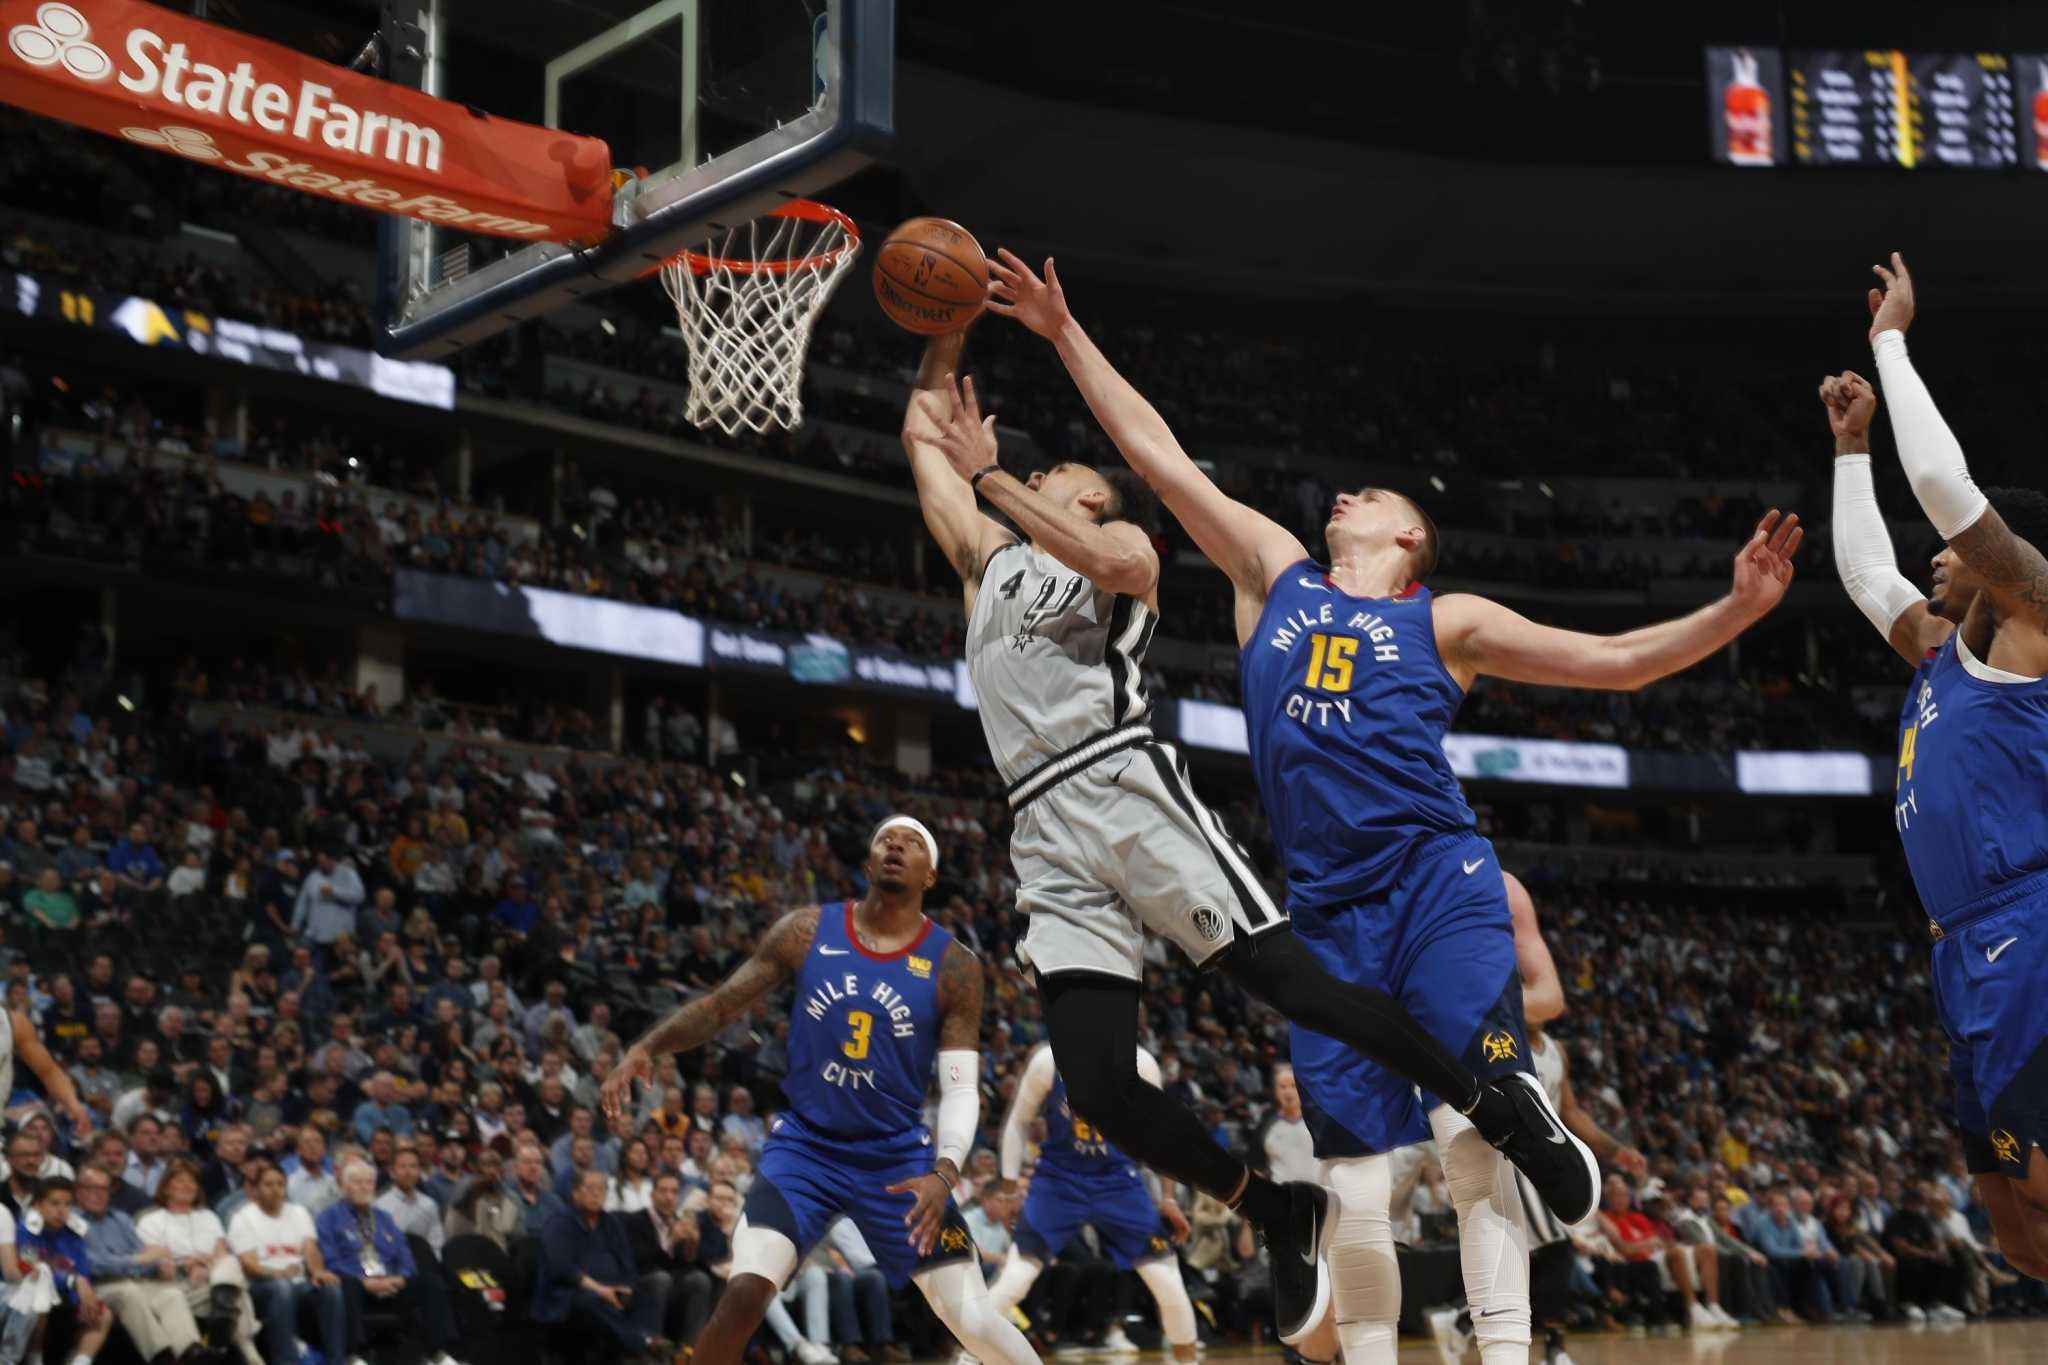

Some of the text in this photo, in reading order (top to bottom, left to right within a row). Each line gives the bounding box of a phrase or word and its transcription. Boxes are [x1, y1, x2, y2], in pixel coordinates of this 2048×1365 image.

[999, 568, 1027, 600] 4
[1271, 603, 1400, 662] MILE HIGH
[1304, 632, 1360, 692] 15
[1286, 694, 1352, 727] CITY
[1897, 720, 1919, 791] 4
[806, 973, 915, 1038] MILE HIGH
[843, 1010, 873, 1060] 3
[822, 1061, 877, 1090] CITY
